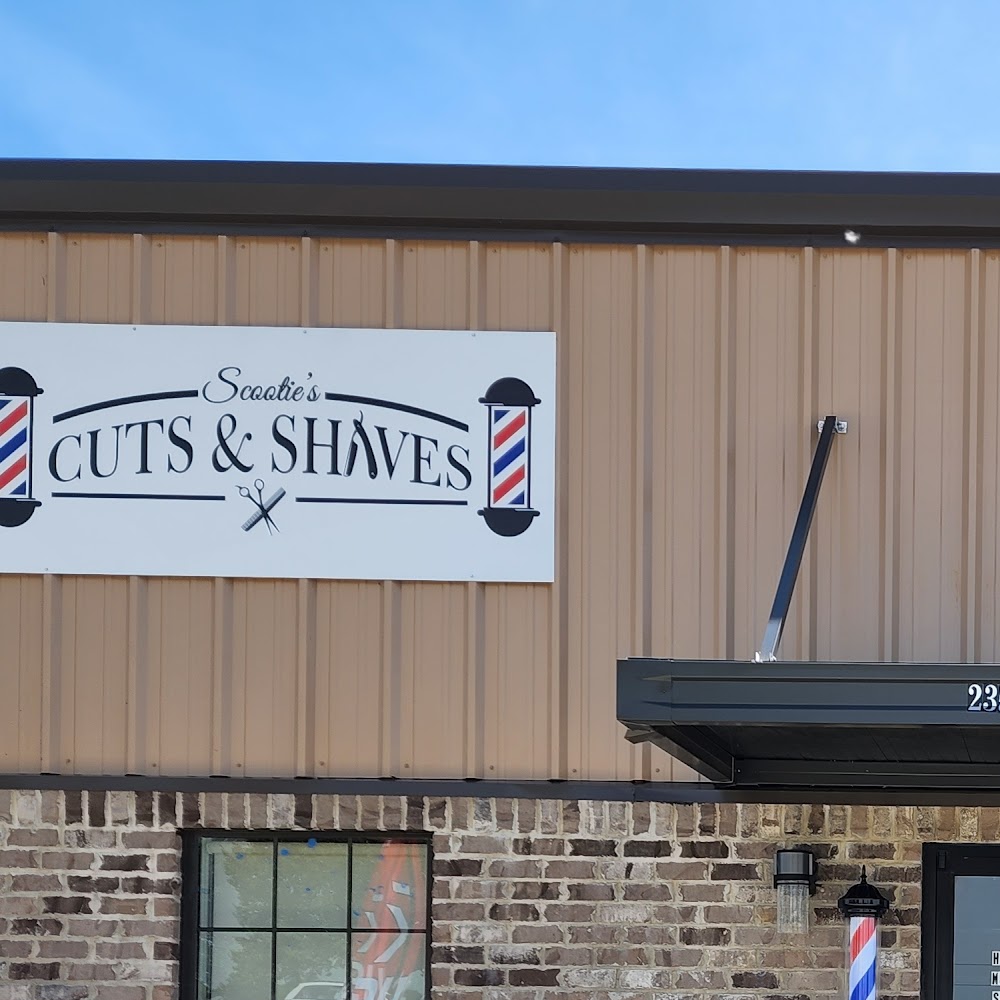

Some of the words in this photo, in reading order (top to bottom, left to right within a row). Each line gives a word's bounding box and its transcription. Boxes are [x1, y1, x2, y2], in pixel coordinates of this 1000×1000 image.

[202, 367, 321, 404] Scootie's
[48, 415, 194, 482] CUTS
[212, 414, 254, 473] &
[271, 410, 472, 491] SHAVES
